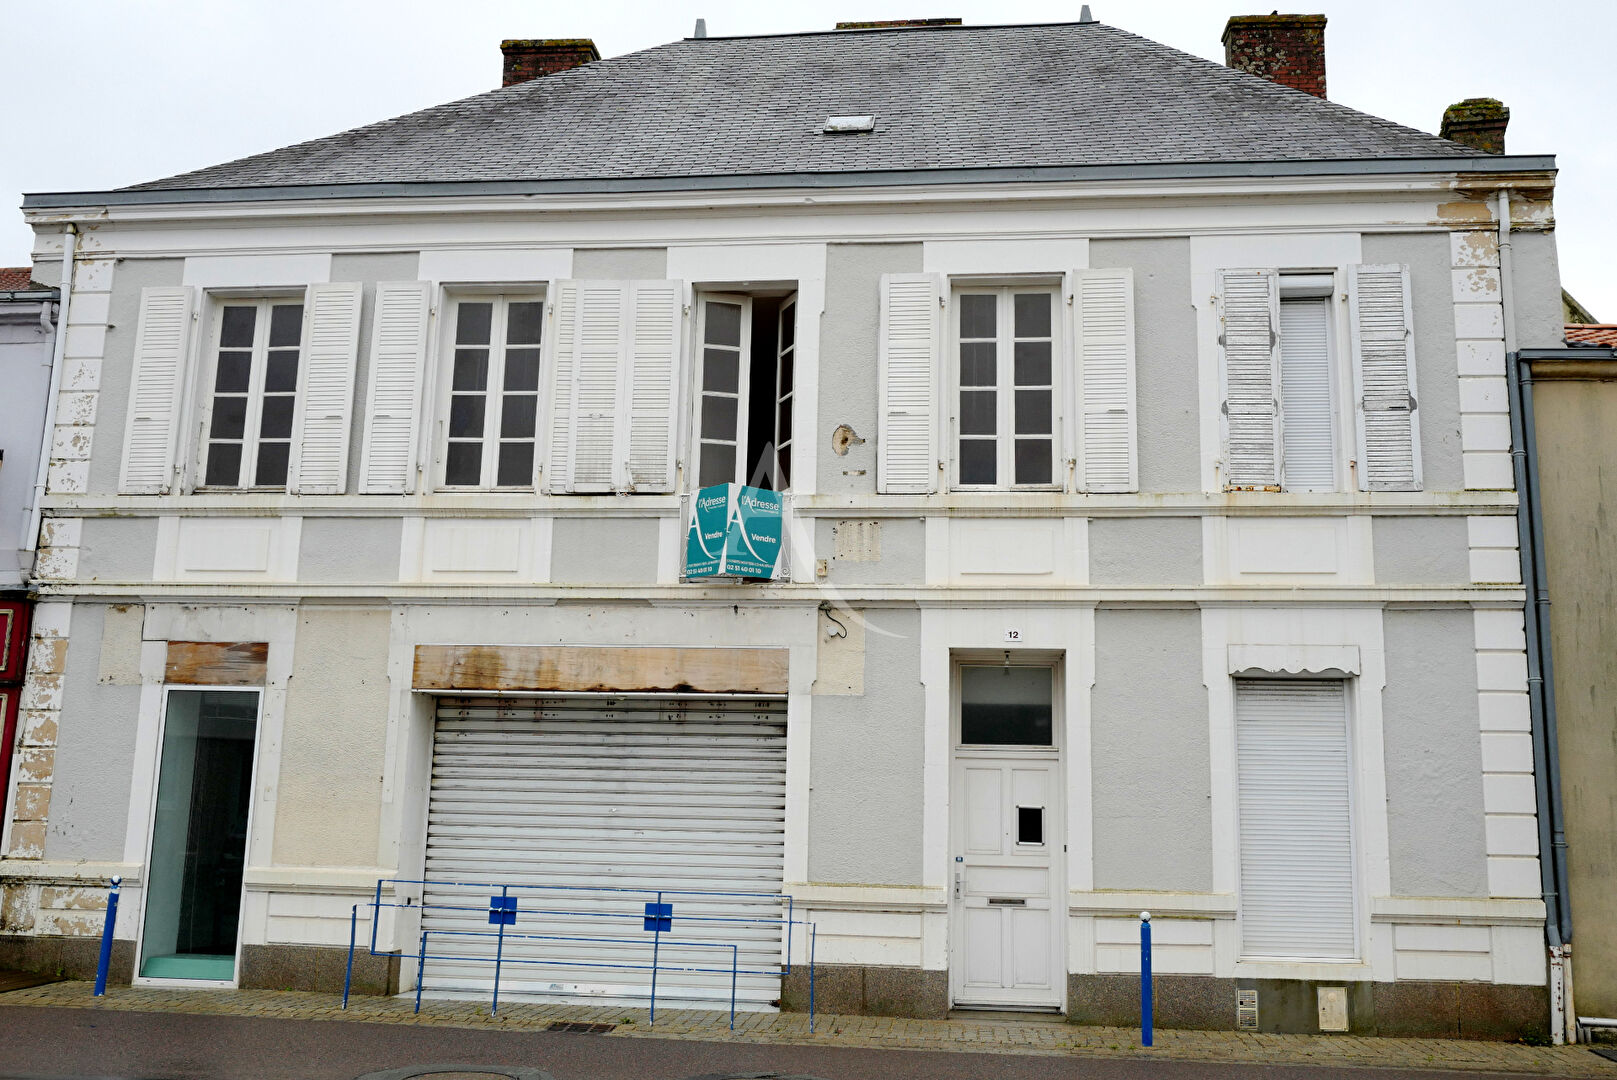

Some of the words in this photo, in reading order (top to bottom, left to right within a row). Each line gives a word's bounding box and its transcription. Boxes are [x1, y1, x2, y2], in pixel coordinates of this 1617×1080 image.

[741, 495, 779, 513] l'Adresse
[704, 531, 723, 540] Vendre
[751, 533, 776, 544] Vendre
[1008, 631, 1019, 639] 12
